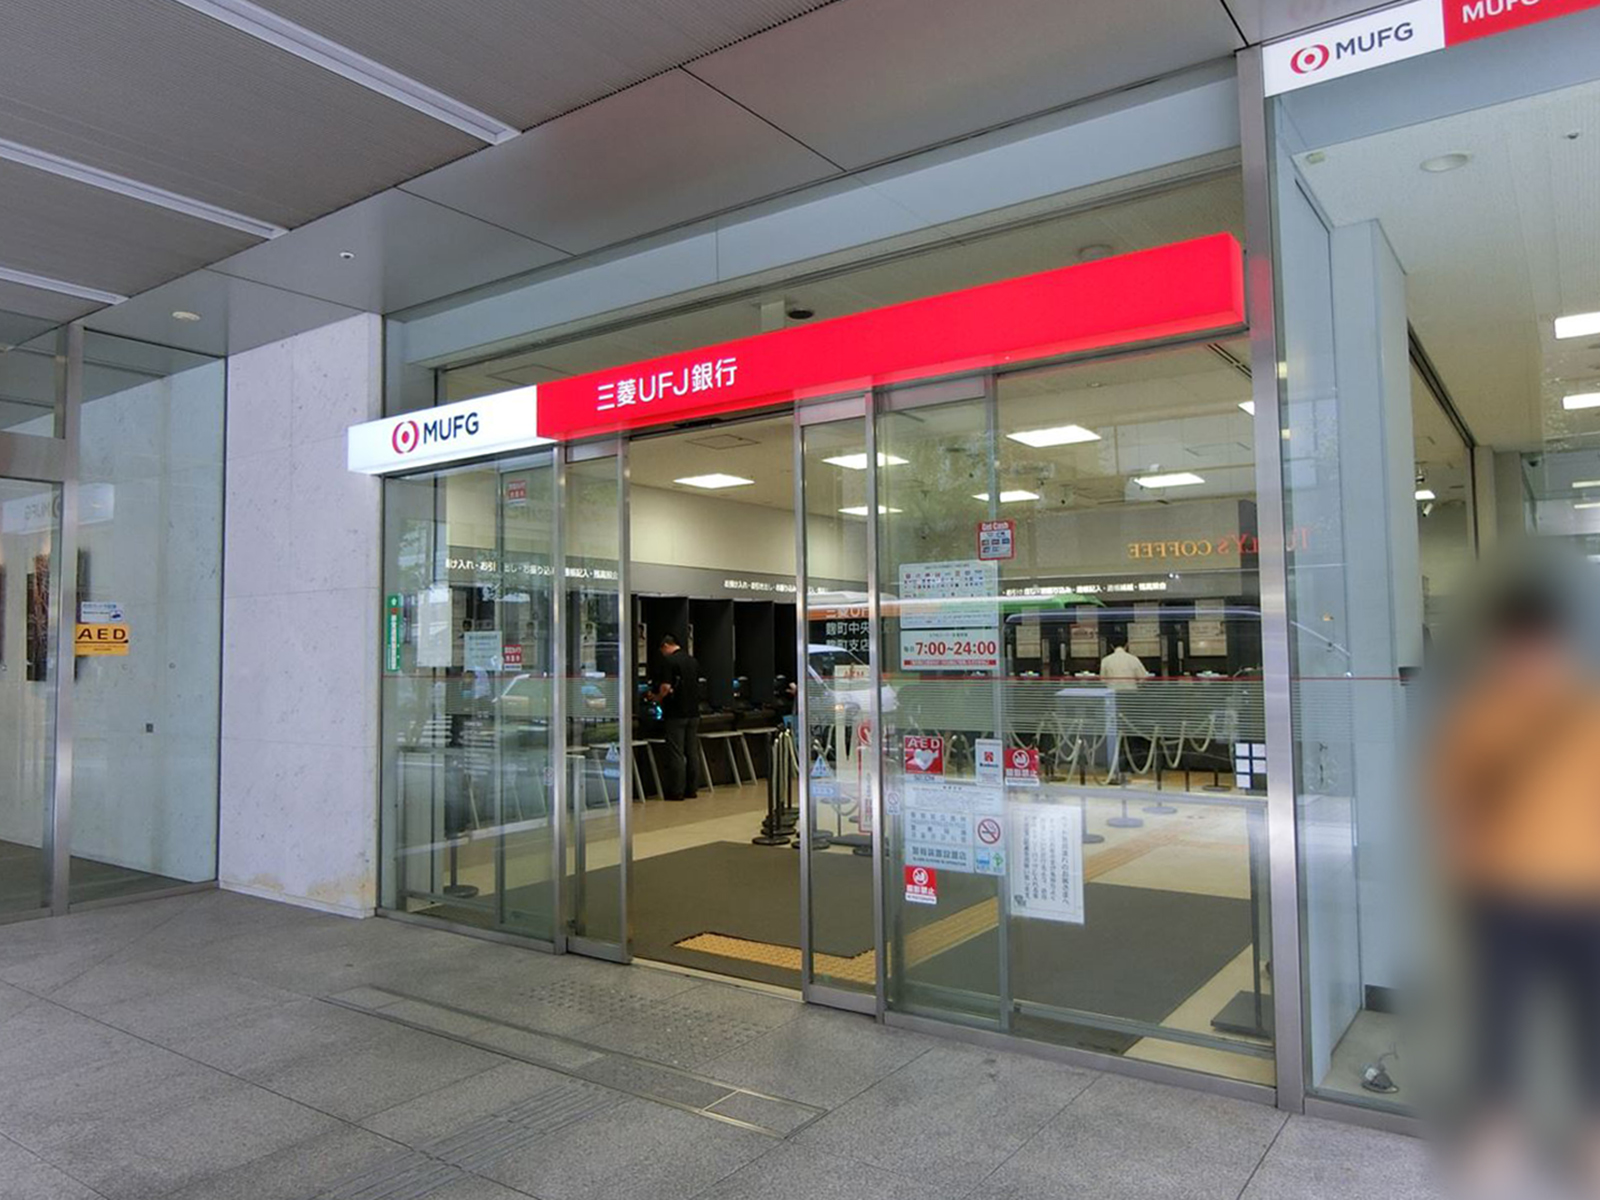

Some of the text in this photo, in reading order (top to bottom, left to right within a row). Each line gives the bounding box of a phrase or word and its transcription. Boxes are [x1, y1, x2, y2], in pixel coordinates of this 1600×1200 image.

[1335, 22, 1413, 60] MUFG
[597, 357, 738, 411] 三菱UFJ銀行
[423, 412, 479, 444] MUFG
[77, 628, 126, 640] AED
[907, 738, 941, 749] AED
